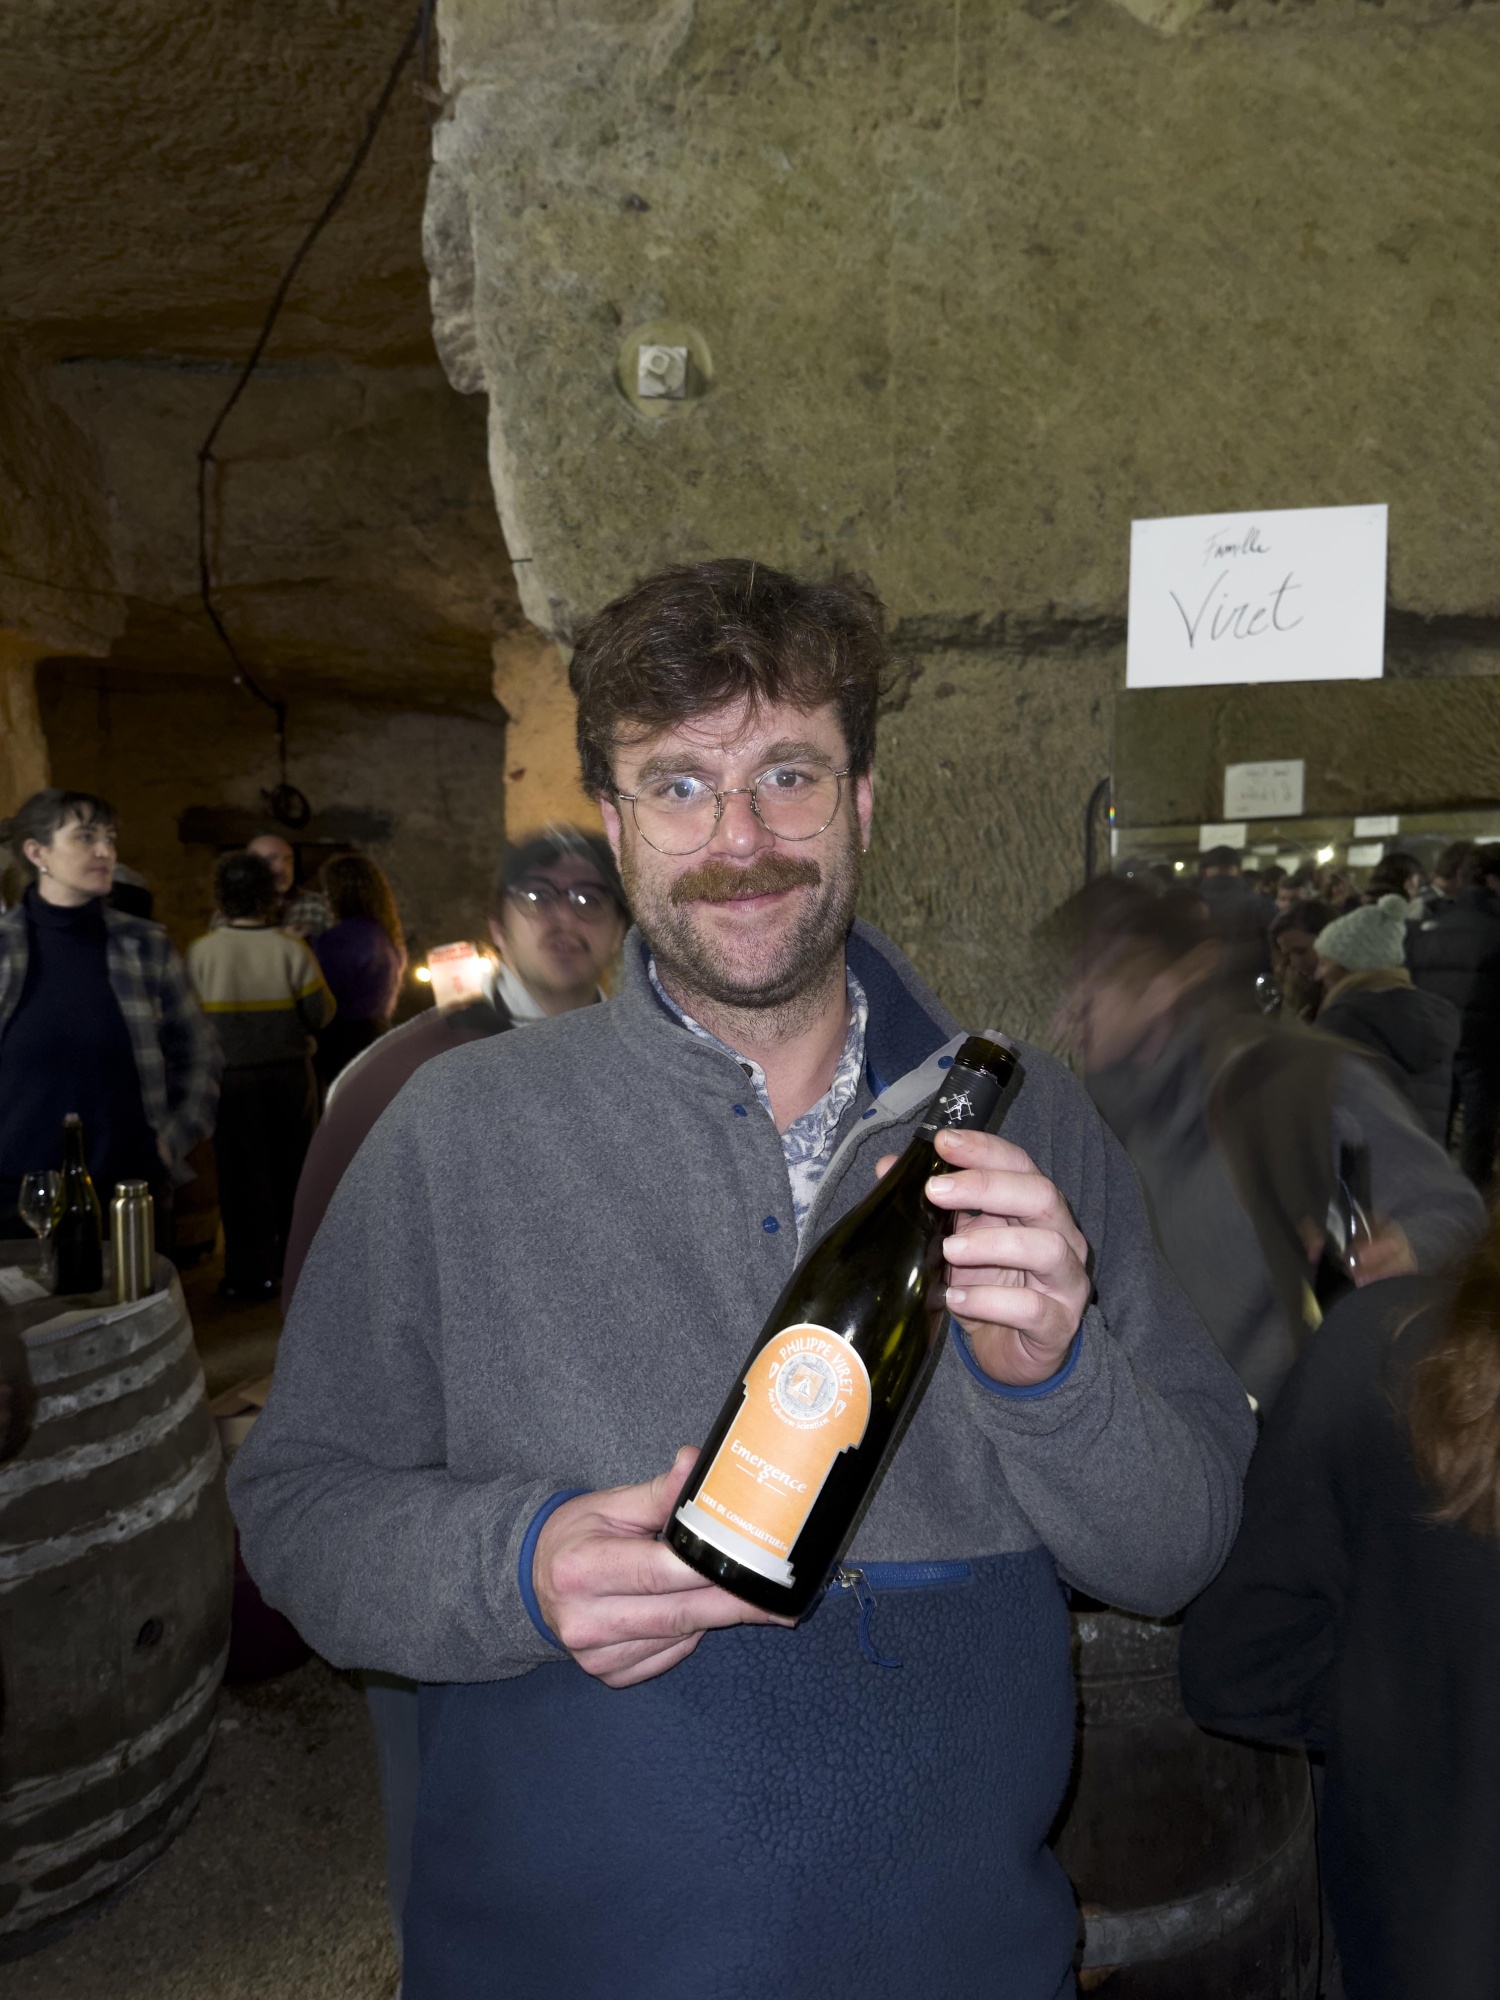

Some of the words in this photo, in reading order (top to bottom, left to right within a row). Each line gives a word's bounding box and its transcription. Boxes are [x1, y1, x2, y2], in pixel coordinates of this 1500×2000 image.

[1202, 526, 1272, 567] Famille
[1169, 569, 1304, 649] Viret
[779, 1337, 833, 1360] PHILIPPE
[831, 1352, 853, 1396] VIRET
[796, 1417, 830, 1430] Scientiam
[730, 1439, 807, 1493] Emergence
[700, 1491, 718, 1510] TERRE
[717, 1504, 727, 1516] DE
